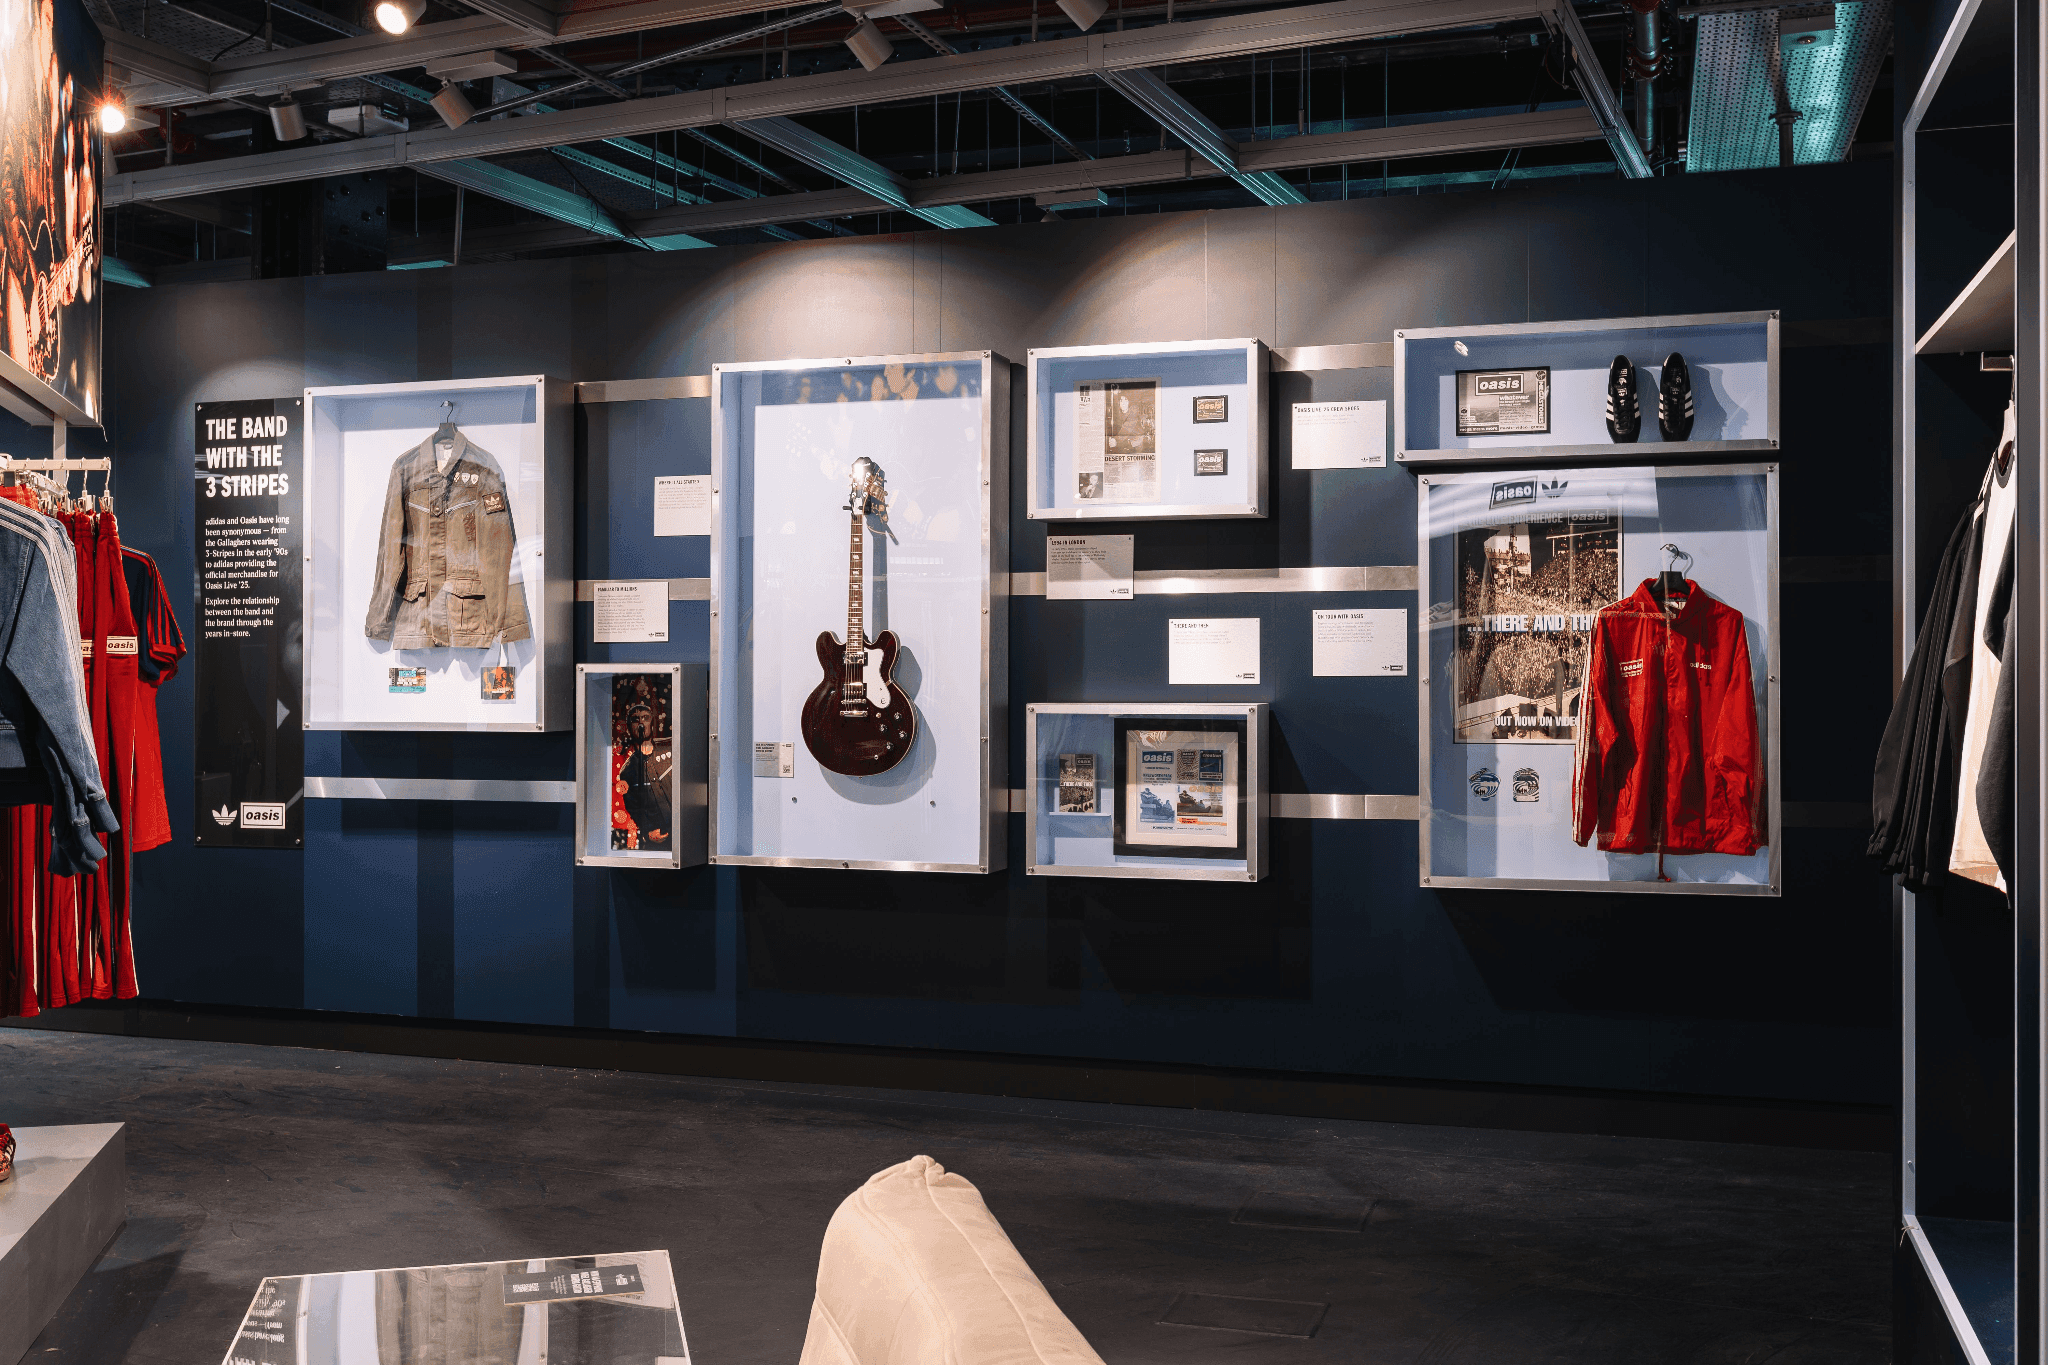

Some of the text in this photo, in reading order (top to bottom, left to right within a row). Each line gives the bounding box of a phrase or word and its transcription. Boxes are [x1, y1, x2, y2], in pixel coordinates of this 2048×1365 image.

[1480, 378, 1519, 390] oasis
[1199, 401, 1222, 409] oasis
[206, 416, 288, 440] THE BAND
[206, 445, 282, 469] WITH THE
[206, 473, 289, 498] 3 STRIPES
[240, 516, 257, 524] Oasis
[276, 515, 290, 524] long
[1572, 511, 1605, 520] oasis
[222, 528, 261, 537] synonymous
[217, 538, 250, 547] Gallaghers
[252, 538, 278, 546] wearing
[206, 549, 235, 558] 3-Stripes
[236, 549, 242, 557] in
[245, 548, 254, 556] the
[256, 548, 272, 557] early
[235, 560, 265, 569] providing
[228, 570, 267, 578] merchandise
[206, 598, 229, 606] Explore
[243, 596, 280, 606] relationship
[236, 618, 261, 627] through
[1534, 614, 1565, 631] AND
[1624, 662, 1642, 671] oasis
[1495, 716, 1578, 726] OUT NOW ON VIDE
[1144, 753, 1172, 761] oasis
[246, 810, 279, 820] oasis
